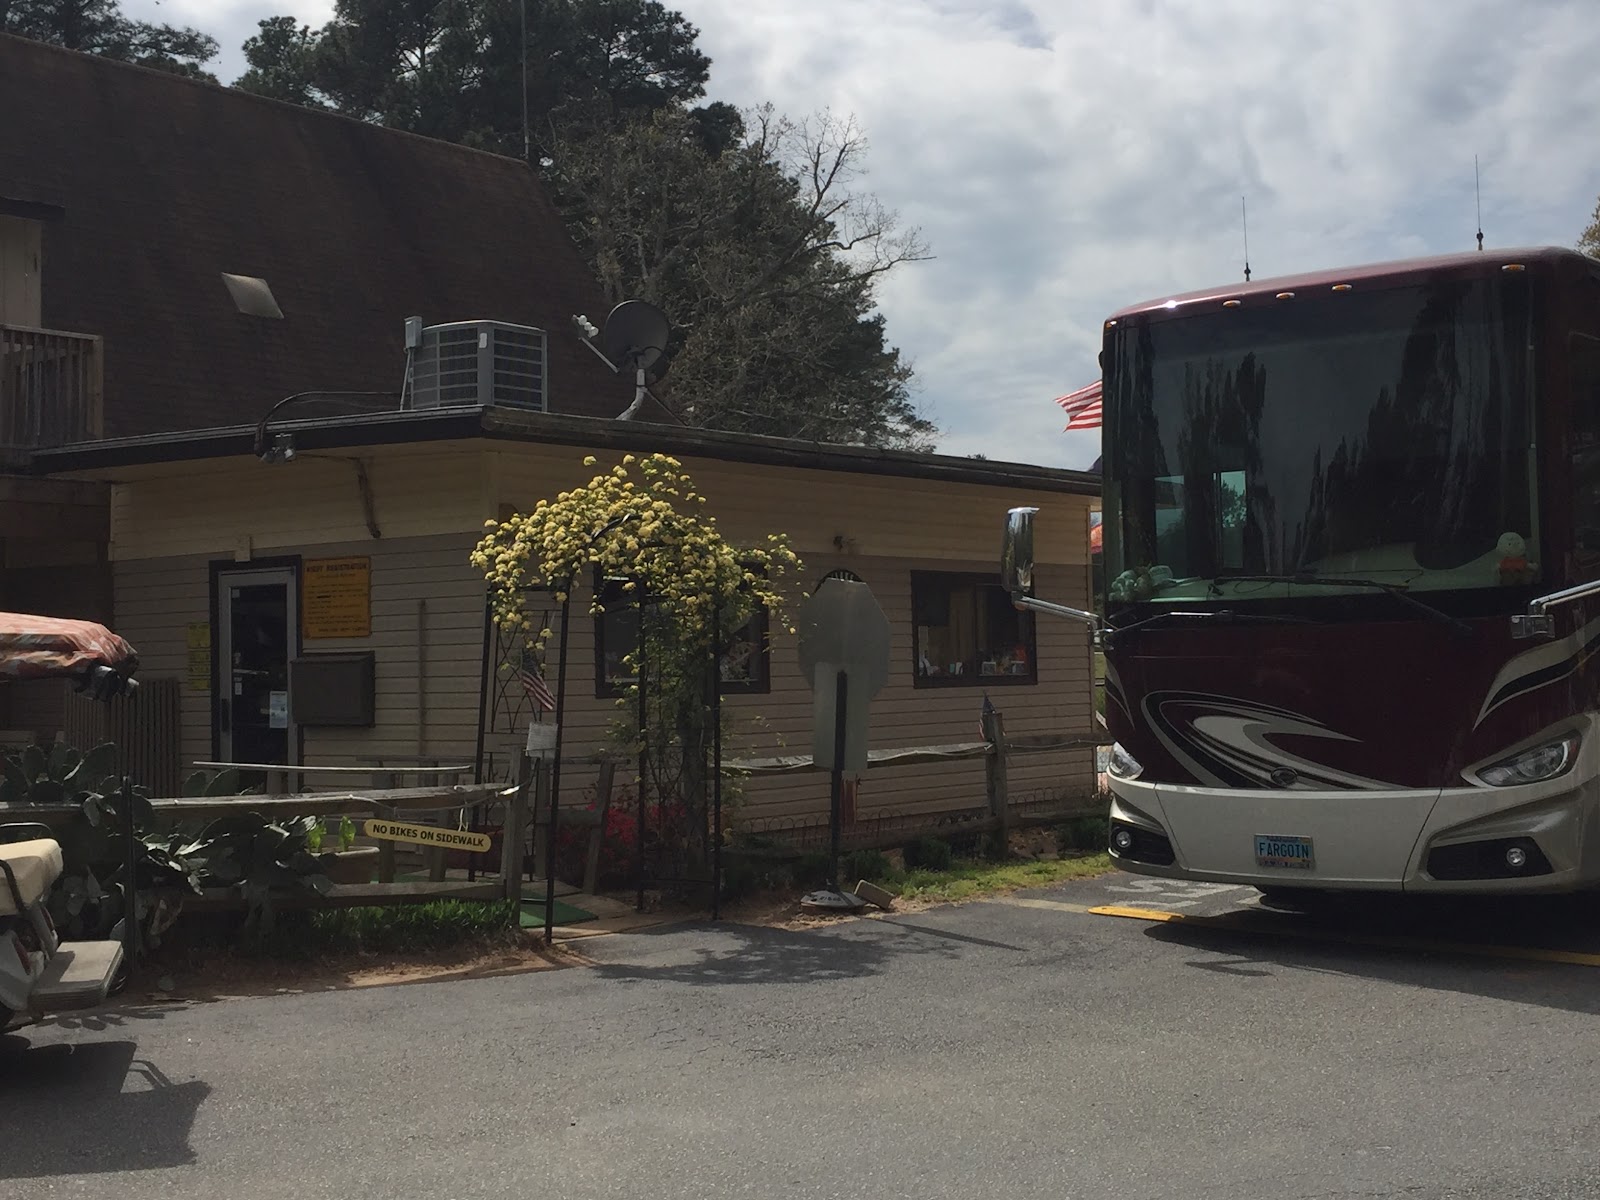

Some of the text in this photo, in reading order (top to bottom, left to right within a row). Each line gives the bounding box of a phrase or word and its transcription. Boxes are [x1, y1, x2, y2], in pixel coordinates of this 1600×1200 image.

[373, 824, 484, 847] NO BIKES ON SIDEWALK
[1259, 842, 1309, 859] FARGOIN
